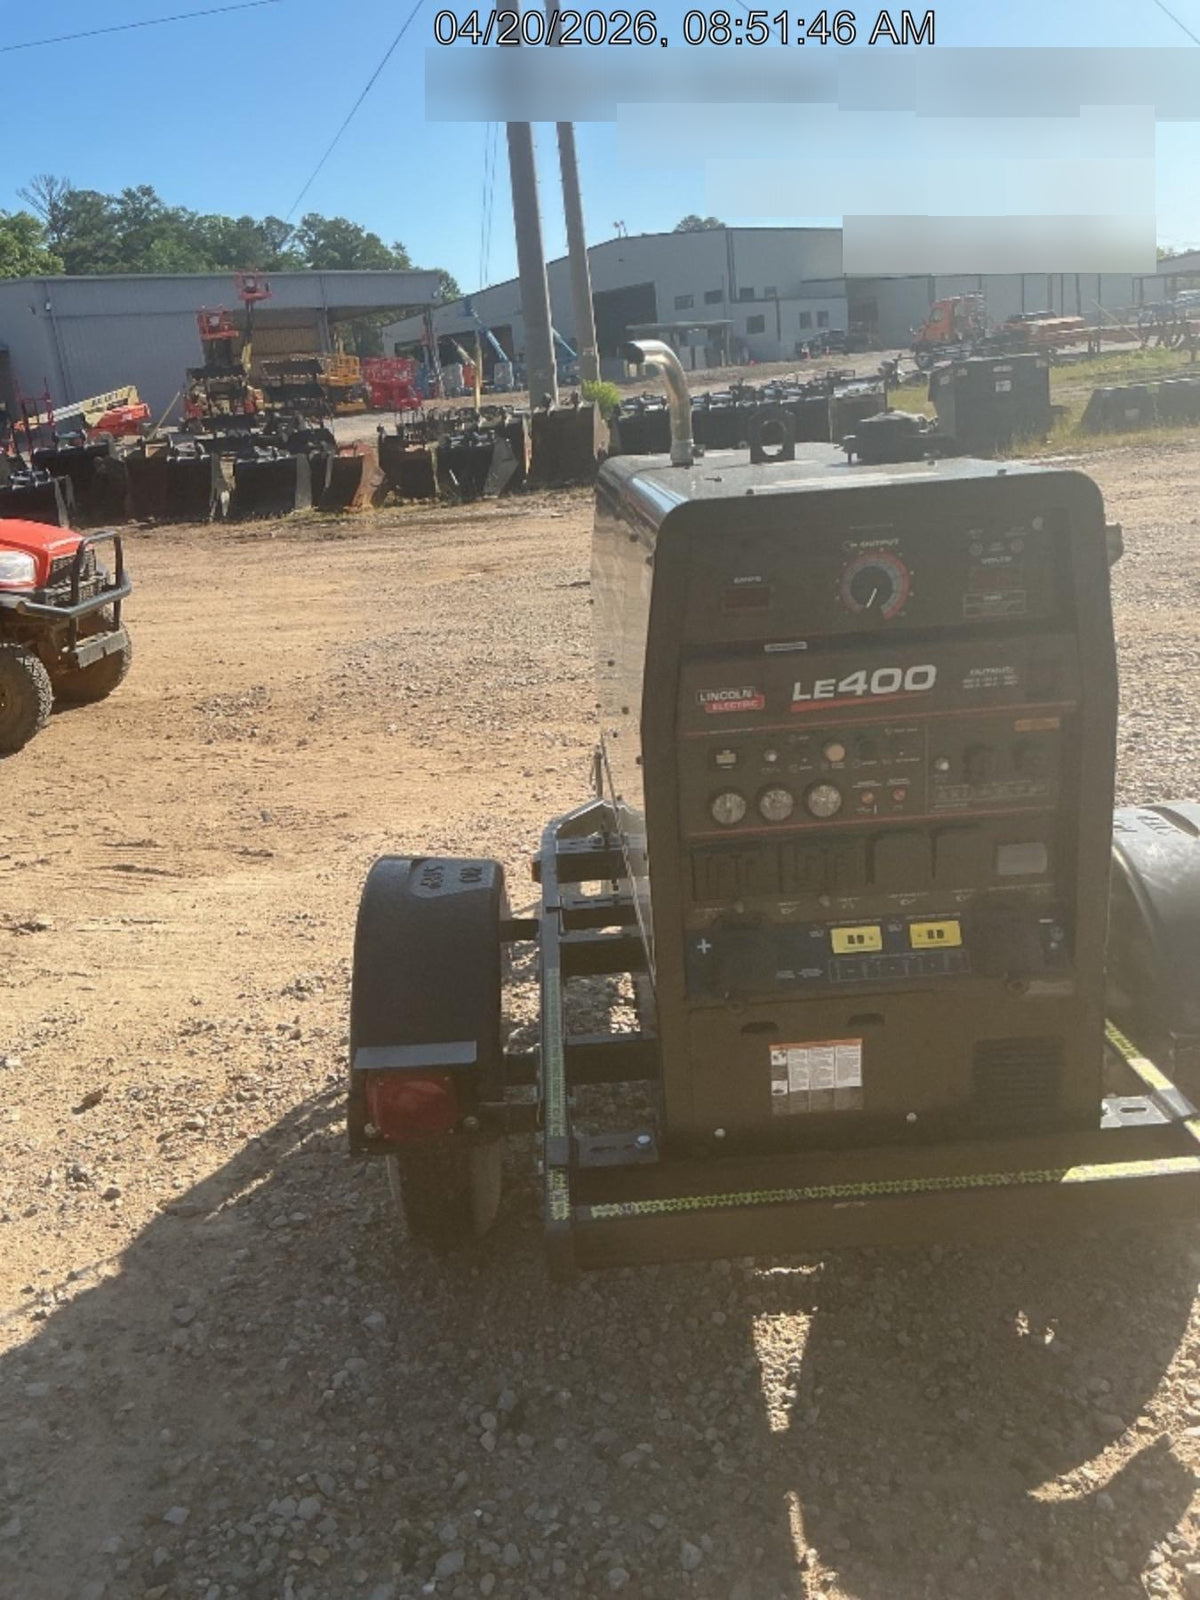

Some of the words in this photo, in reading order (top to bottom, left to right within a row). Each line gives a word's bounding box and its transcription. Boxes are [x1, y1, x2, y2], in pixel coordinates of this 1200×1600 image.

[792, 663, 938, 702] LE400
[699, 688, 753, 702] LINCOLN
[711, 699, 759, 711] ELECTRIC
